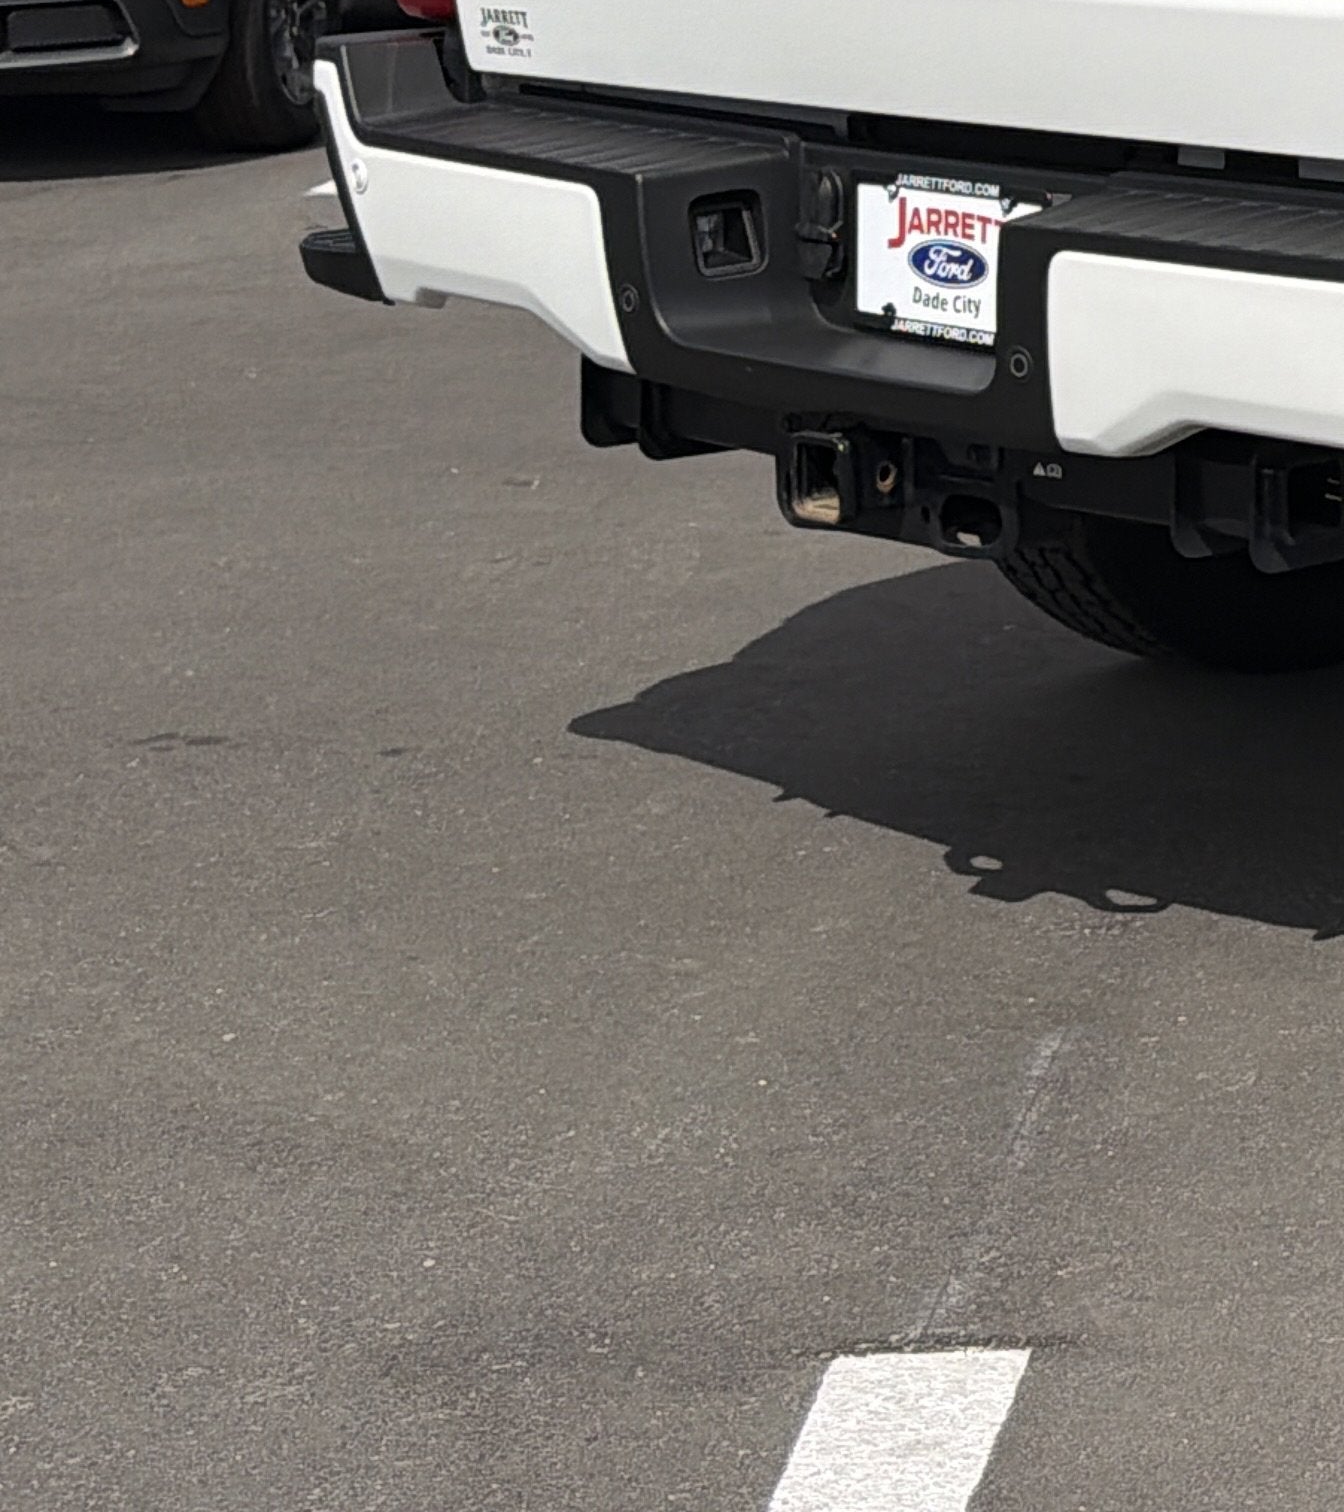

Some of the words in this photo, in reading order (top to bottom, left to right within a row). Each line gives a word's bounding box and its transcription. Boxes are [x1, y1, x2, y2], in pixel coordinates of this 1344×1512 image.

[895, 173, 1000, 195] JARRETTFORD.COM
[888, 196, 1005, 249] JARRET
[923, 245, 974, 281] Ford
[912, 286, 949, 312] Dade
[952, 294, 982, 319] City
[890, 318, 995, 347] JARRETTFORD.COM
